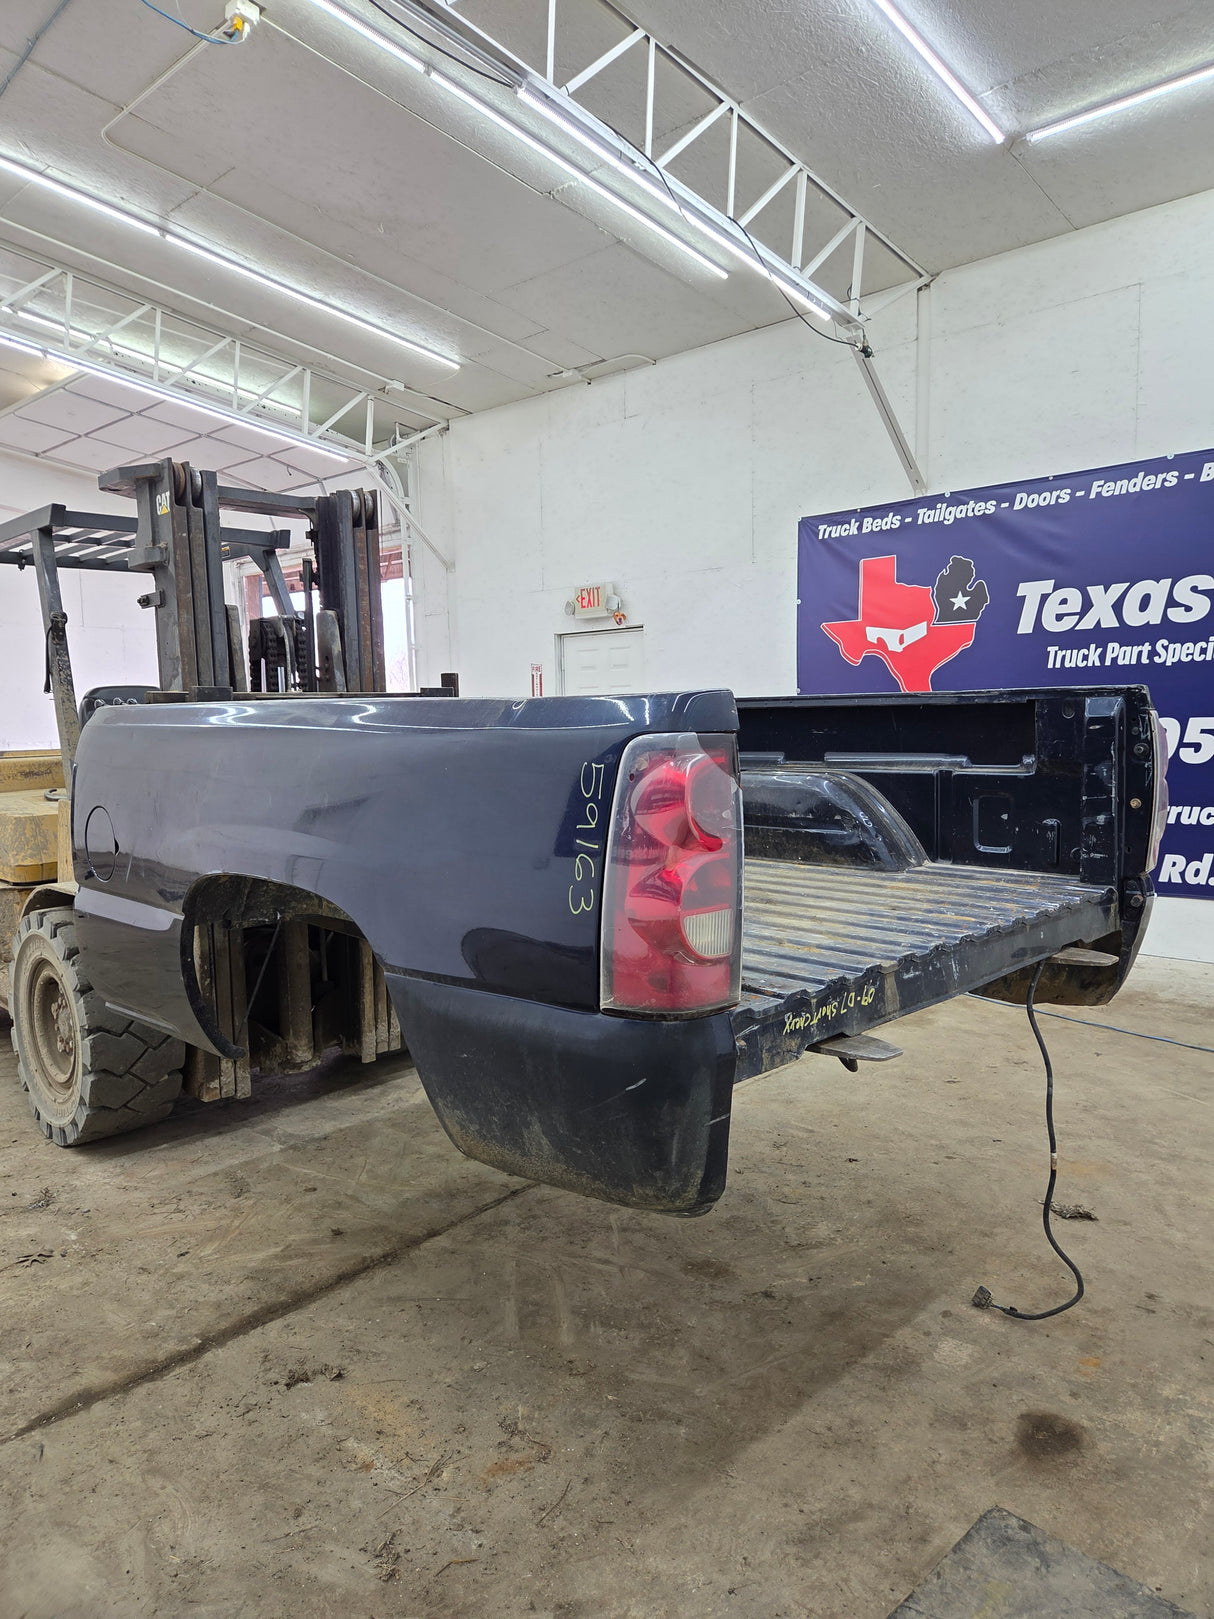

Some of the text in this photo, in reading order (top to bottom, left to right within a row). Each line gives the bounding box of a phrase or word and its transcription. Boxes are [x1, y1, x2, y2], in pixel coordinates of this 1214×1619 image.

[155, 490, 171, 516] CAT
[817, 518, 859, 540] Truck
[861, 512, 902, 533] Beds
[916, 500, 997, 525] Tailgates
[1013, 489, 1071, 510] Doors
[1089, 470, 1179, 499] Fenders
[1199, 461, 1214, 482] B
[580, 586, 601, 609] EXIT
[1016, 574, 1214, 635] Texas
[1047, 636, 1214, 668] Truck Part Speci
[1165, 805, 1214, 826] ruc
[568, 761, 605, 915] 59163
[1158, 853, 1214, 887] Rd.
